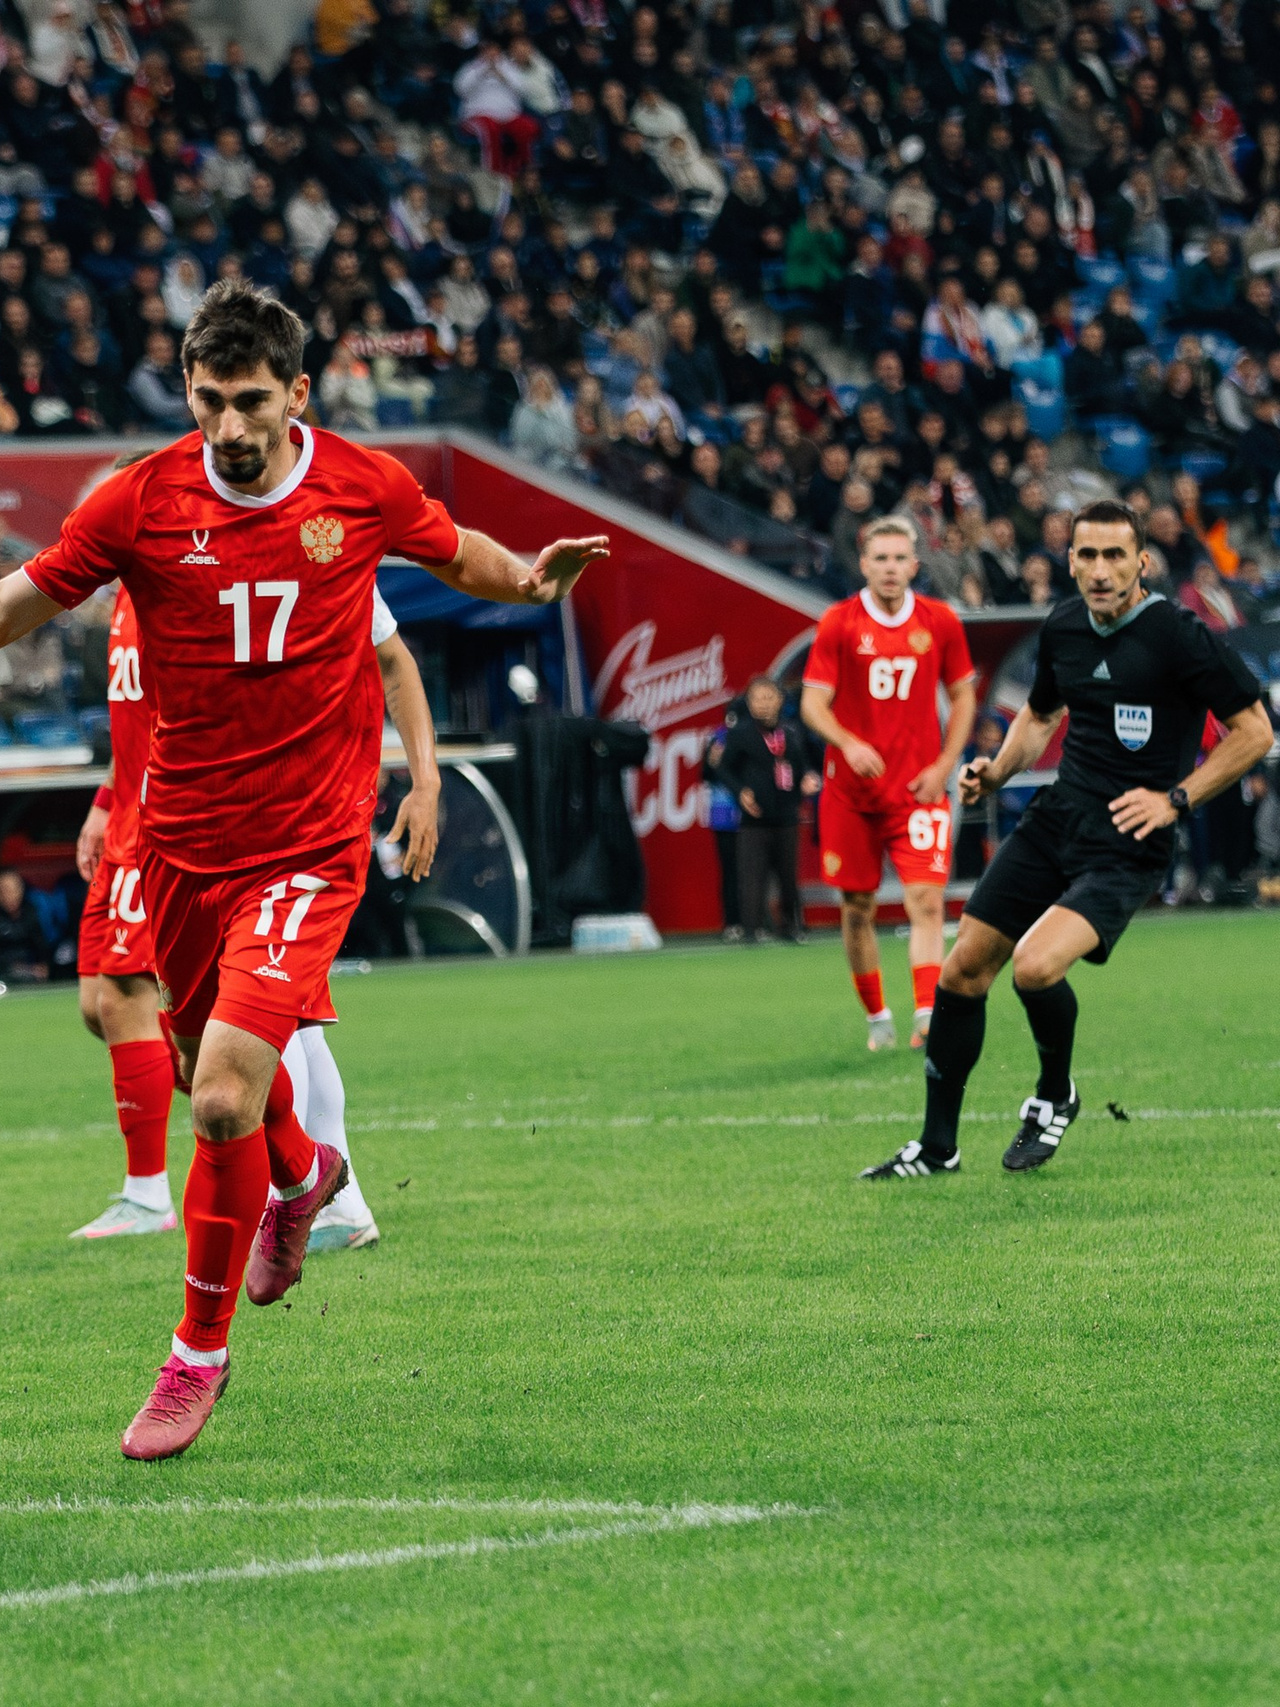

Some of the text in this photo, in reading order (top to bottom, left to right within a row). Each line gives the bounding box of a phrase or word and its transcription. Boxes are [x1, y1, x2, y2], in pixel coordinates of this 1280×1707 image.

[179, 553, 220, 565] JÖGEL
[218, 581, 300, 663] 17
[107, 646, 145, 702] 20
[868, 656, 918, 701] 67
[1118, 708, 1148, 721] FIFA
[907, 808, 950, 851] 67
[253, 874, 331, 942] 17
[252, 965, 292, 982] JÖGEL
